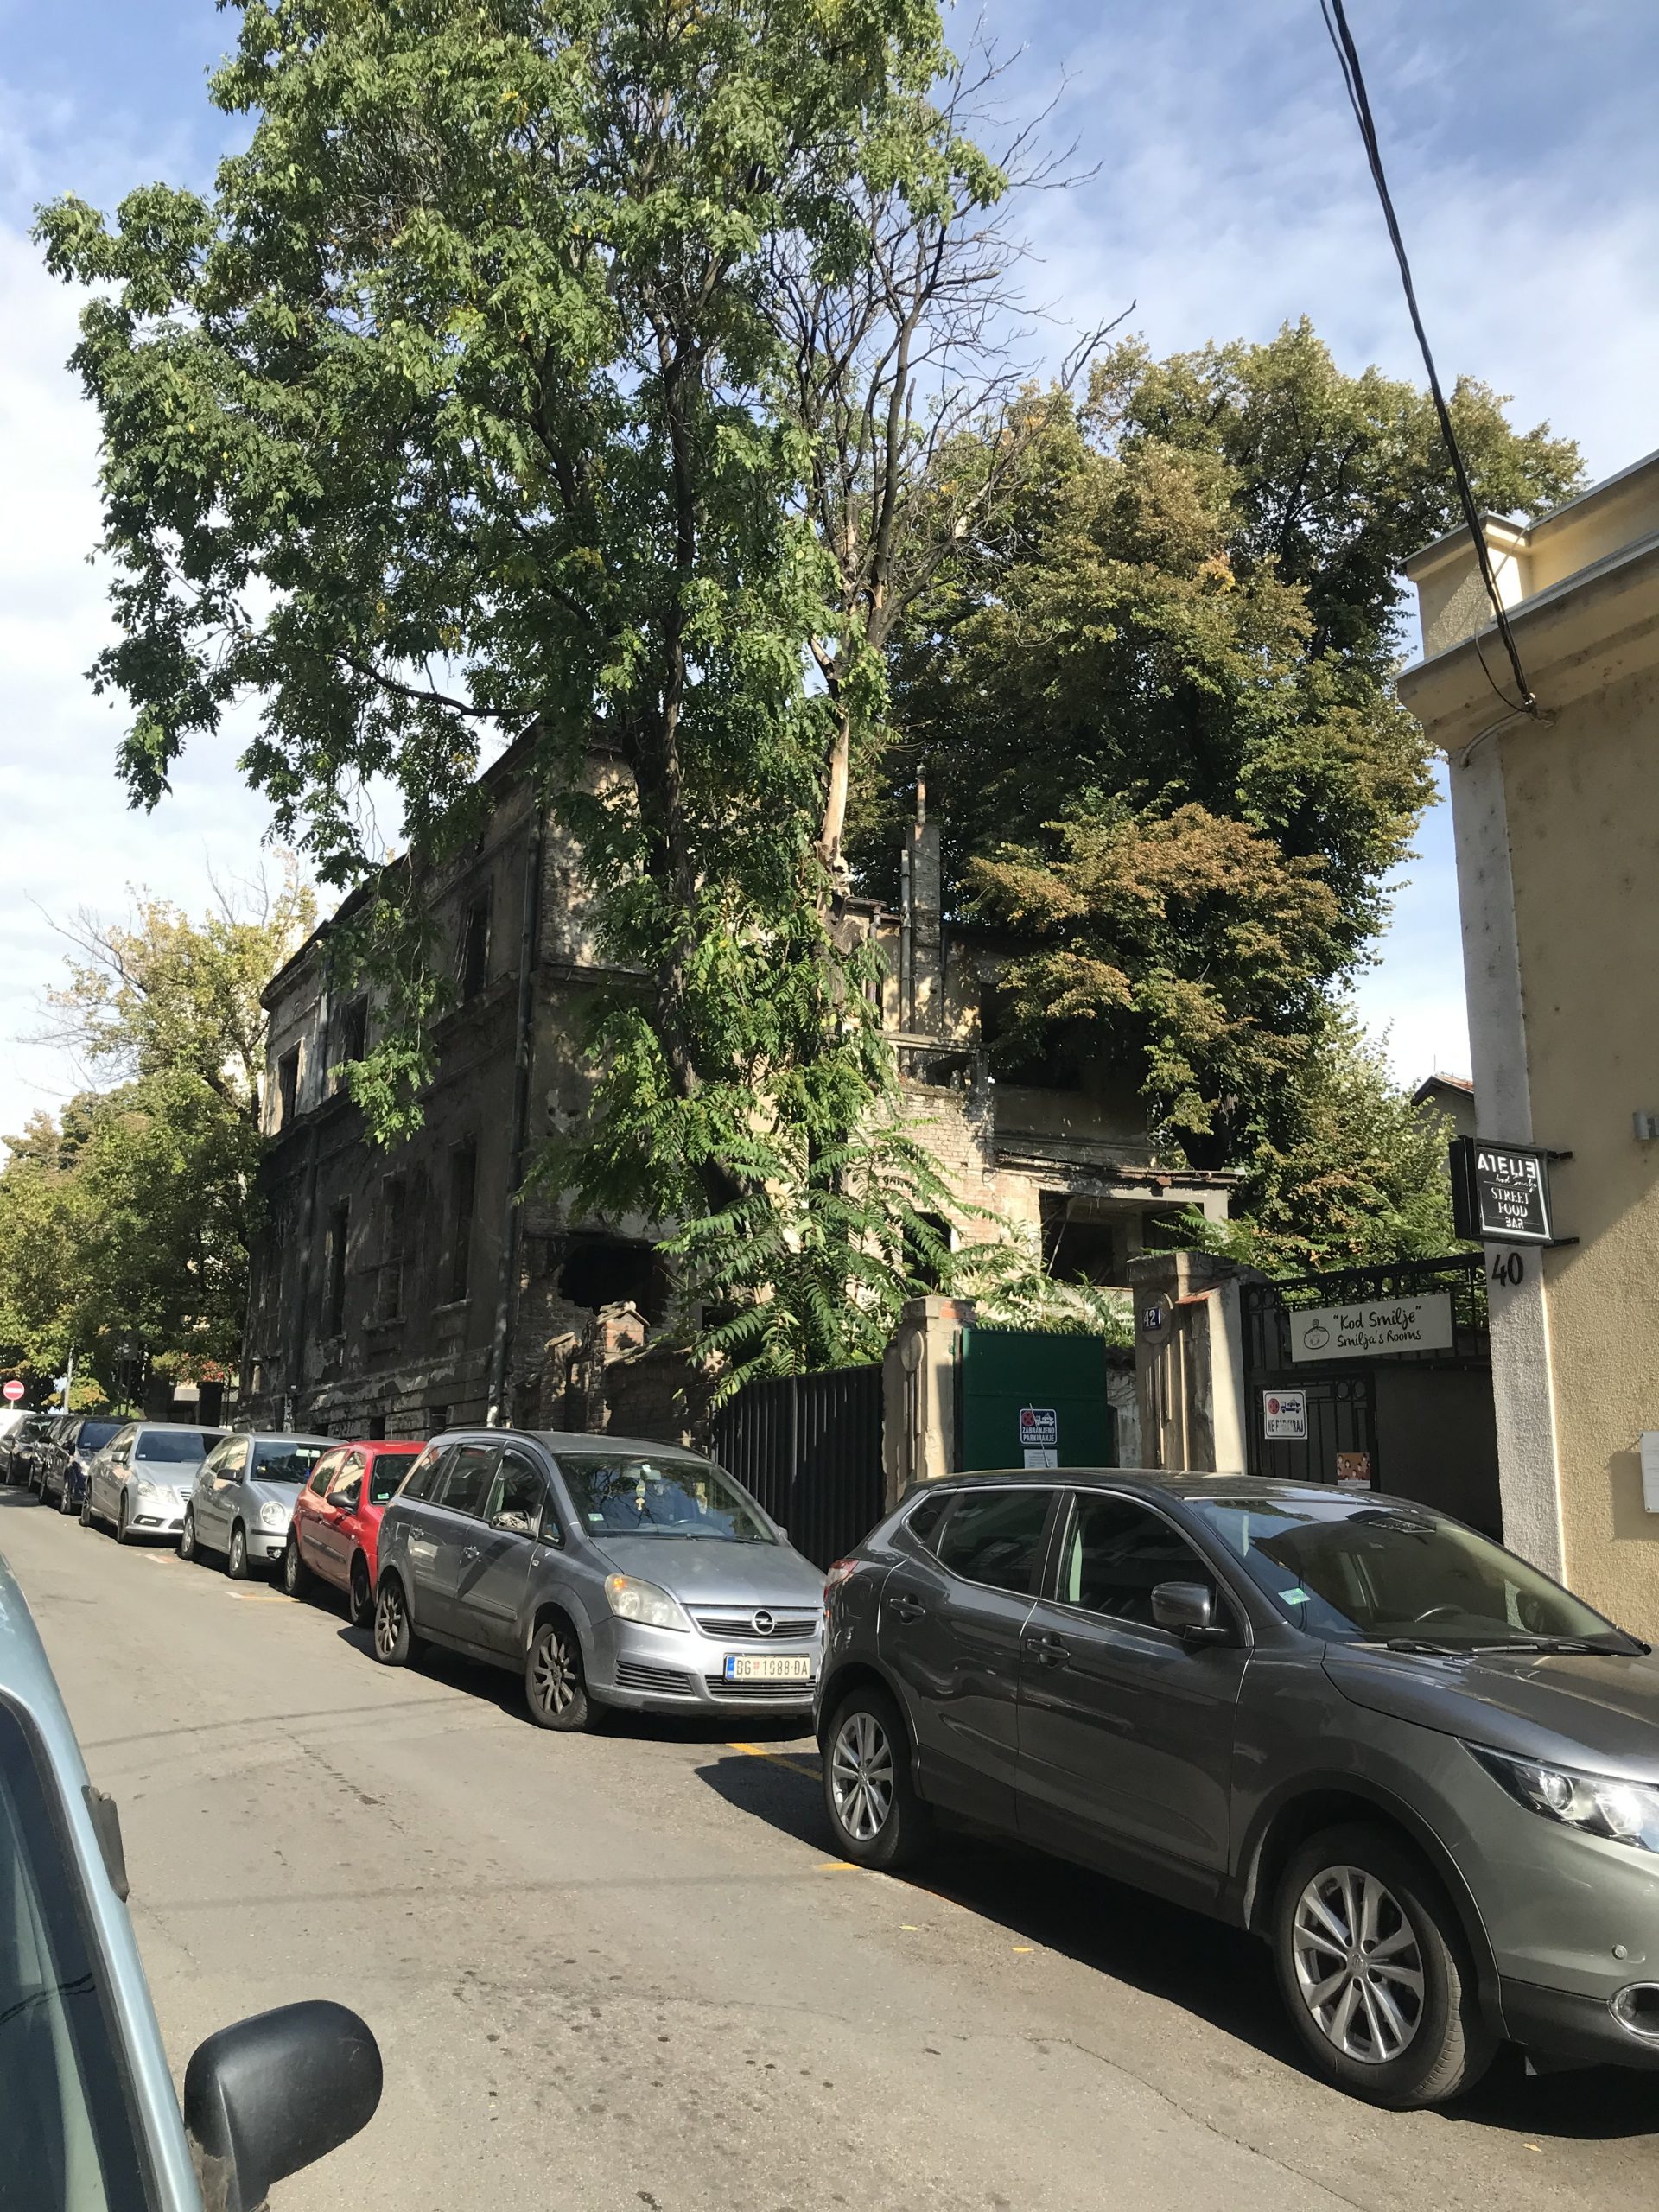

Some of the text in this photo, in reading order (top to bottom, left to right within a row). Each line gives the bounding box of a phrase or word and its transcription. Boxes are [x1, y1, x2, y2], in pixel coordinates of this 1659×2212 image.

[1491, 1187, 1530, 1205] STREET
[1498, 1202, 1528, 1217] FOOD
[1505, 1217, 1524, 1230] BAR
[1491, 1253, 1524, 1287] 40
[1144, 1309, 1156, 1327] 42
[1337, 1330, 1421, 1350] Smilja's Rooms
[736, 1660, 751, 1675] BG
